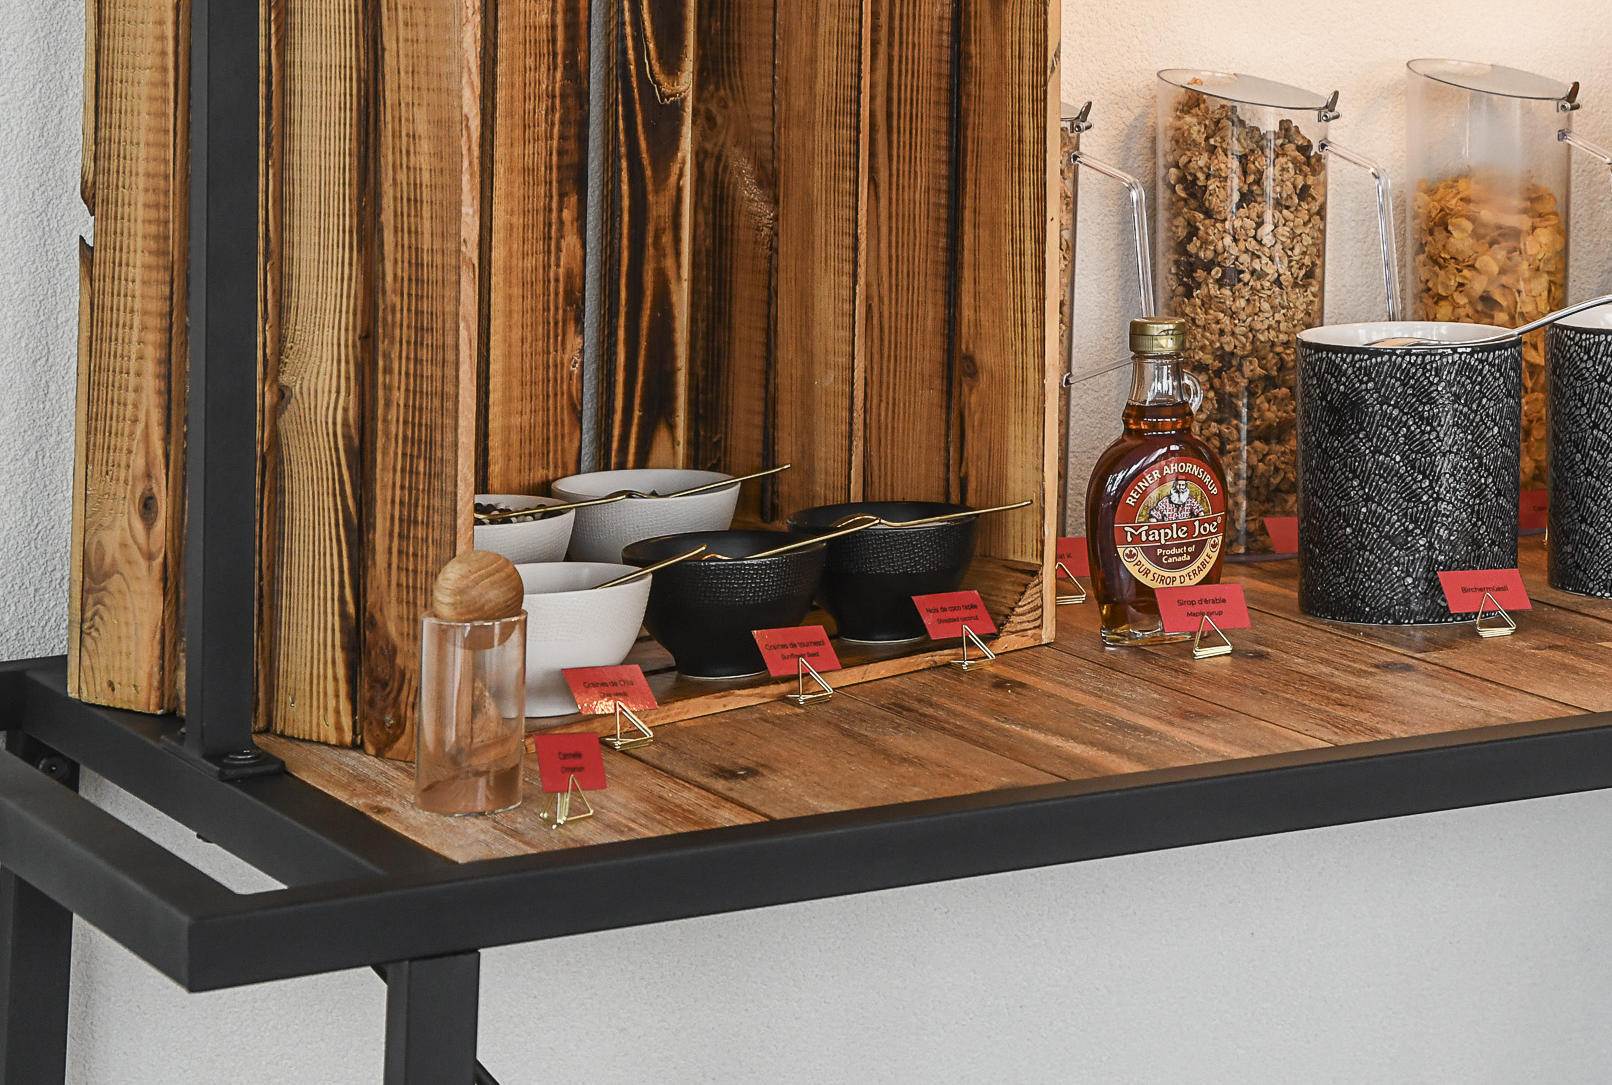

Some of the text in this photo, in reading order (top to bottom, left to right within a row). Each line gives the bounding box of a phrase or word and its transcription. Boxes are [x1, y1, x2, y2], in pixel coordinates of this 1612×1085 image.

[1125, 462, 1218, 507] REINER AHORNSIRUP
[1123, 522, 1189, 545] Maple
[1157, 544, 1196, 556] Product of
[1162, 554, 1191, 563] Canada
[1133, 553, 1213, 586] PUR SIROP D'ERABLE
[1177, 597, 1227, 606] Sirop d'érable
[797, 639, 825, 647] tournesol
